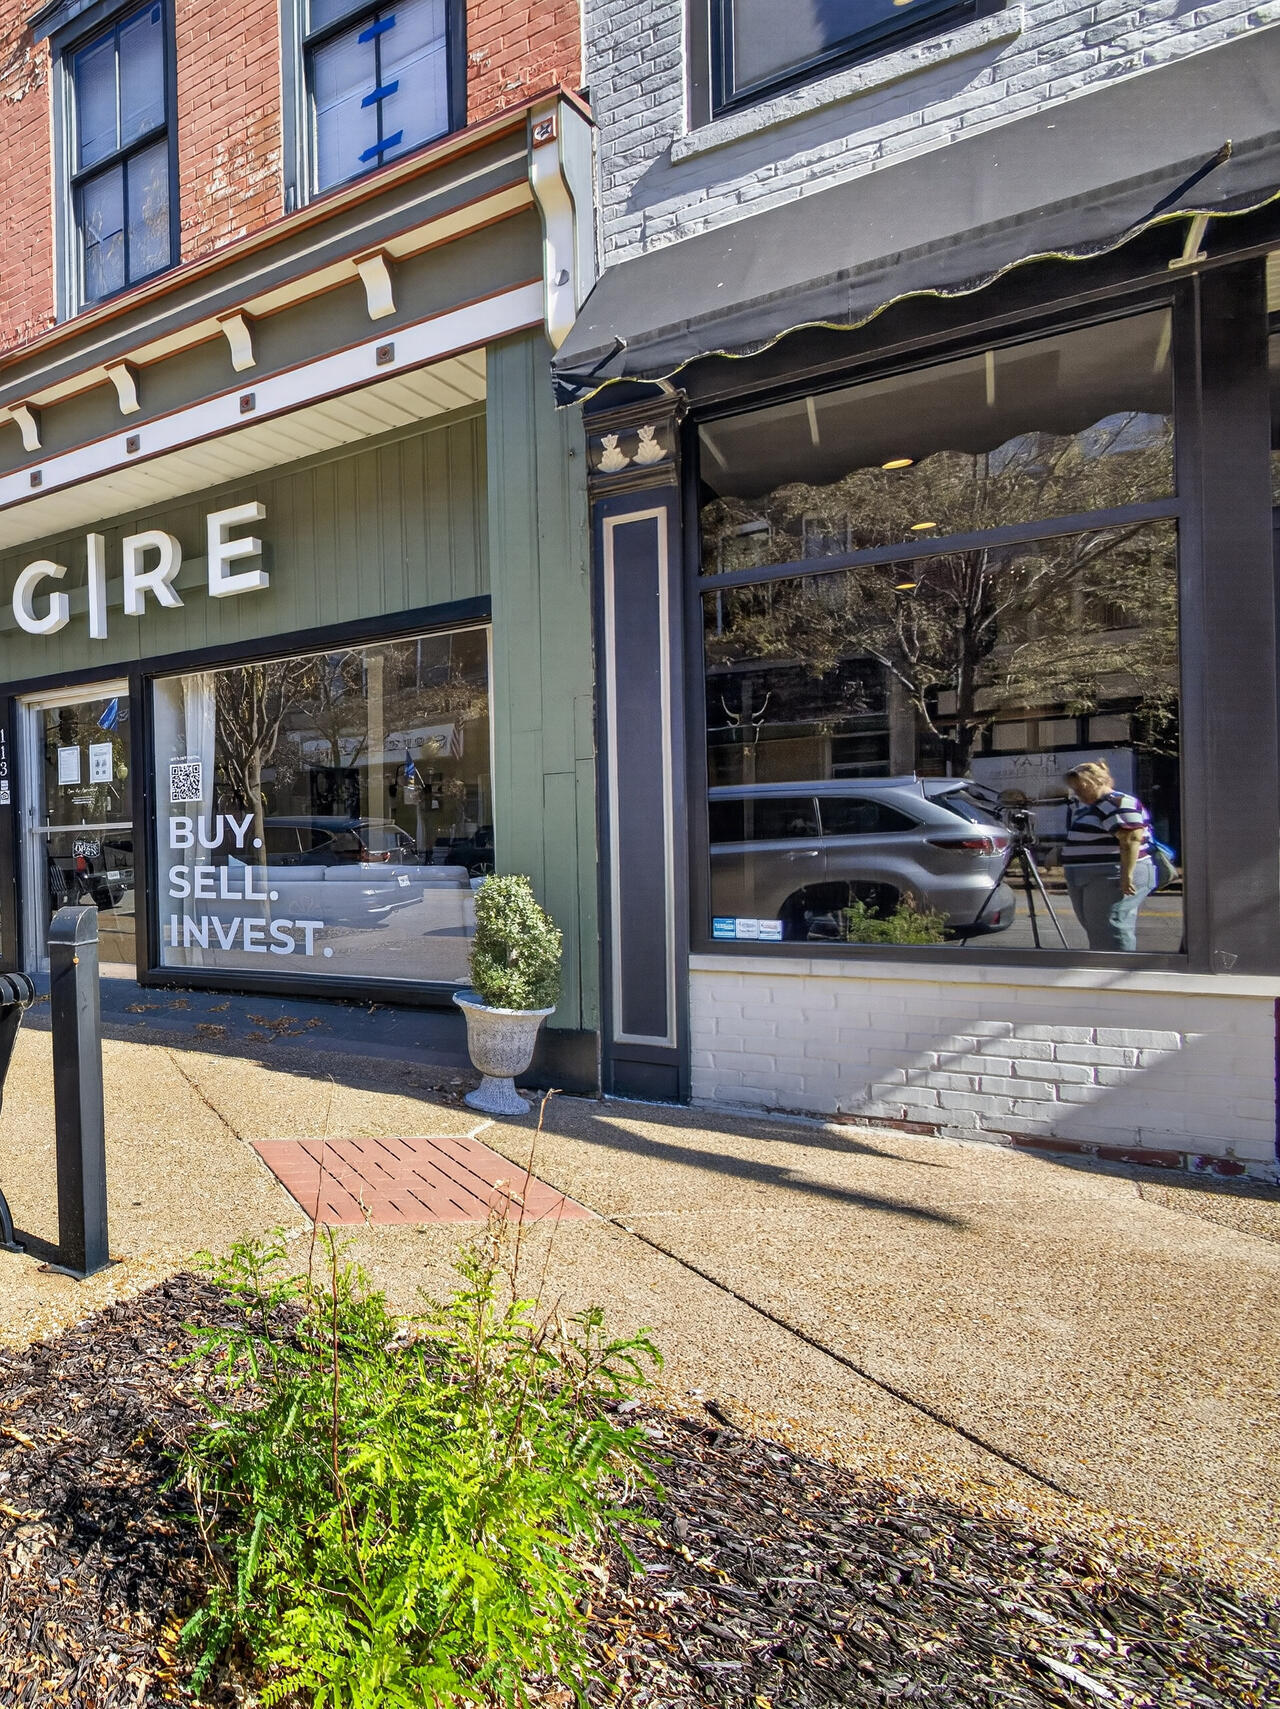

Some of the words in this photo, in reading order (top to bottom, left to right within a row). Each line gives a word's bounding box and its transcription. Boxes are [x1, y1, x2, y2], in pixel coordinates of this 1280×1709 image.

[169, 813, 263, 849] BUY.
[169, 864, 279, 901] SELL.
[170, 914, 334, 958] INVEST.
